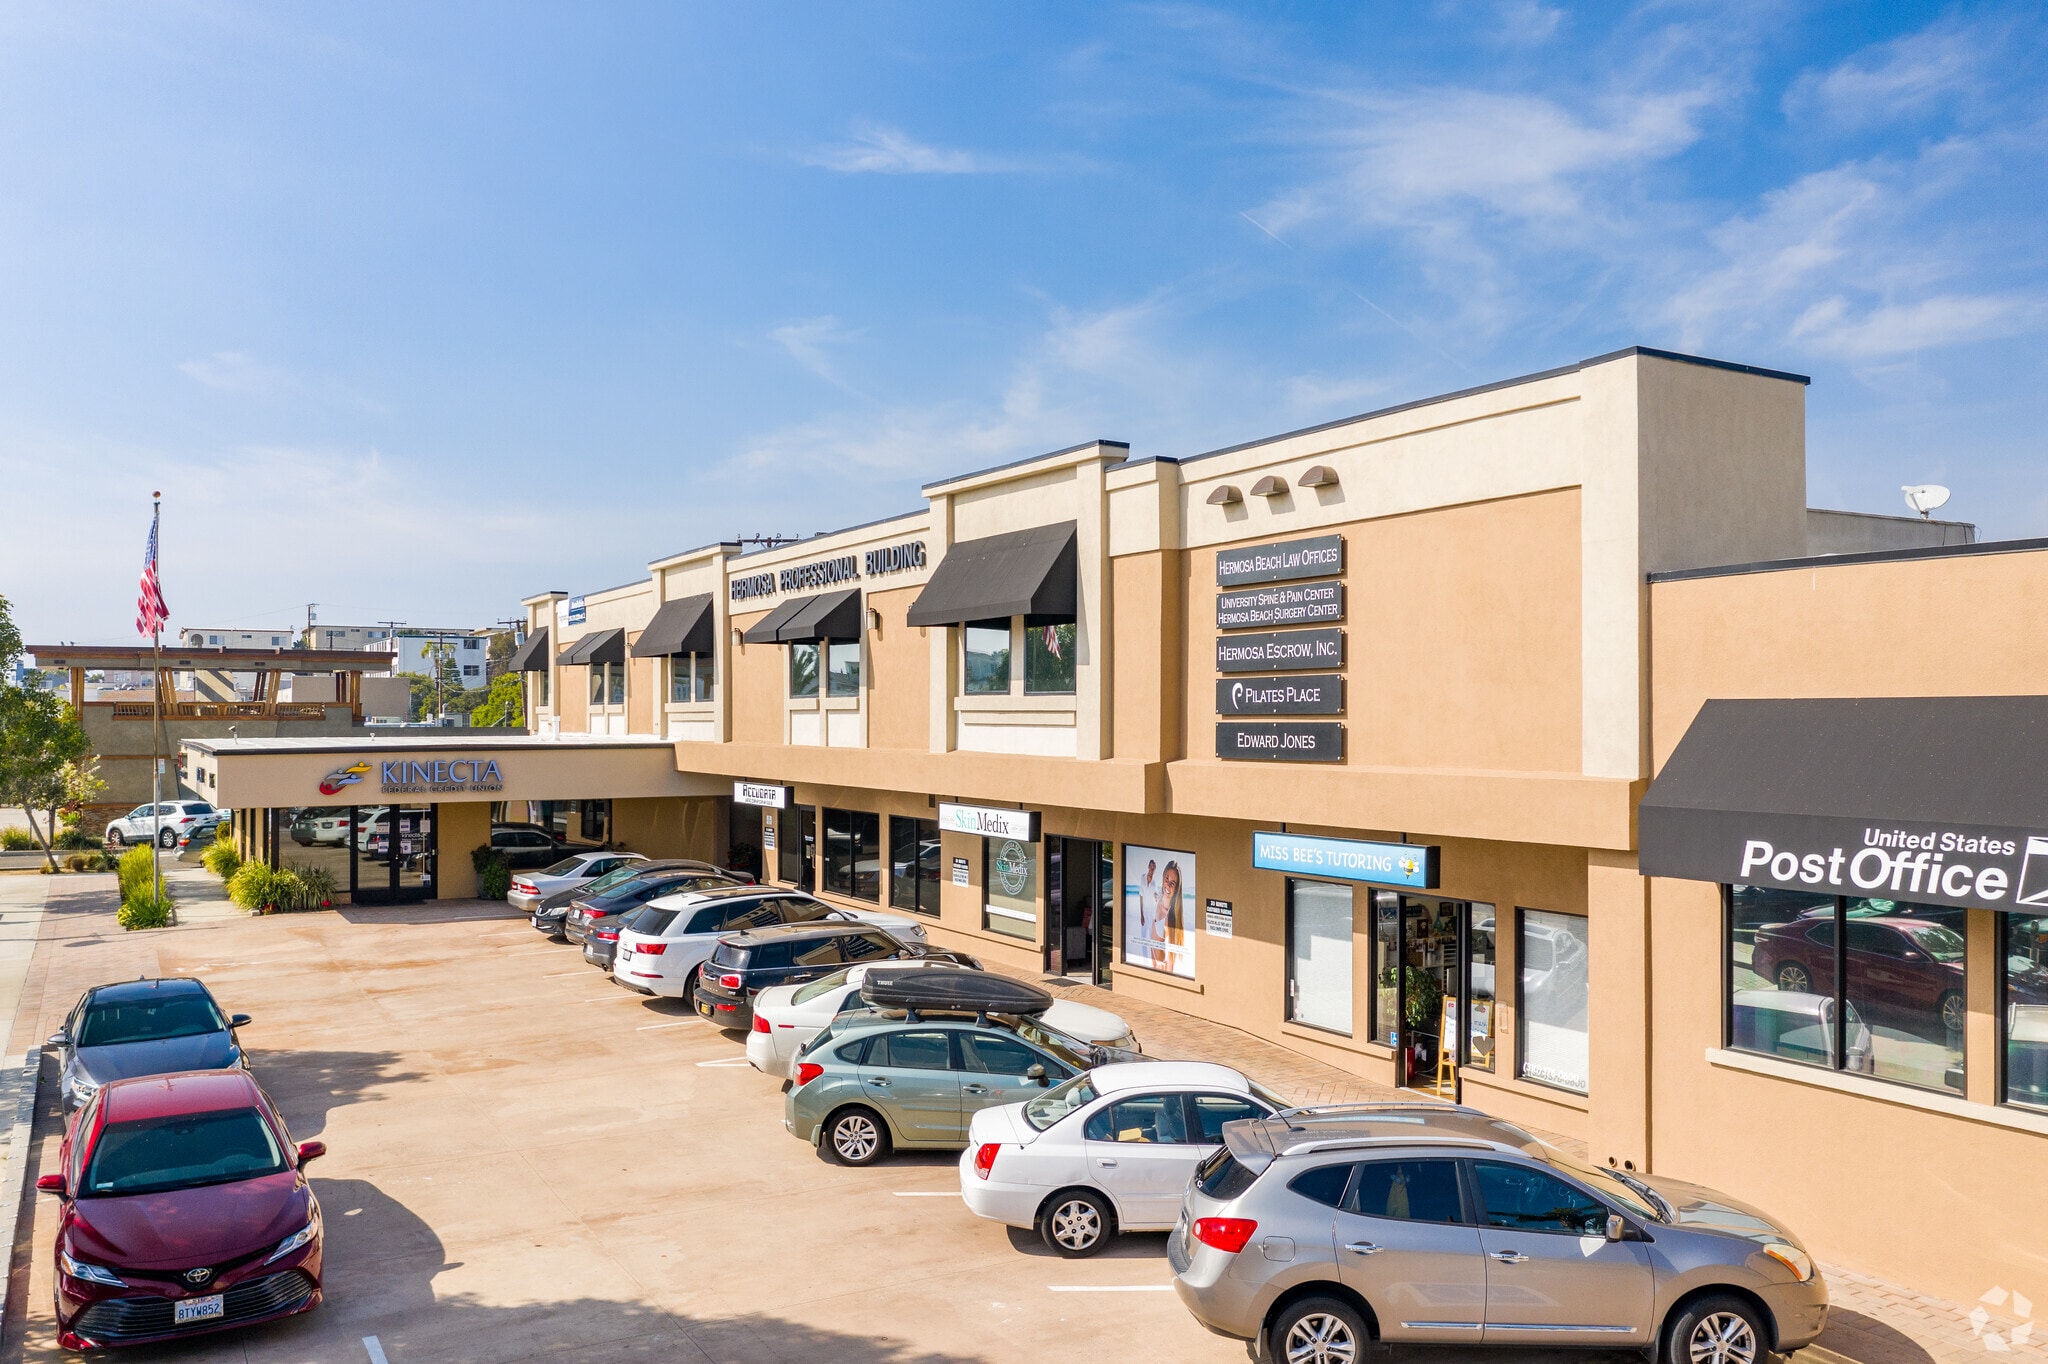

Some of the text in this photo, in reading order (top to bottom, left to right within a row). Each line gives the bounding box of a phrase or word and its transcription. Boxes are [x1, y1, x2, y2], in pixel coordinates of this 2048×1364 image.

[731, 540, 926, 600] HERMOSA PROFESSIONAL BUILDING
[1219, 548, 1338, 576] HERMOSA BEACH LAW OFFICES
[1221, 587, 1334, 609] UNIVERSITY SPINE & PAIN CENTER
[1218, 603, 1338, 624] HERMOSA BEACH SURGERY CENTER
[1218, 639, 1338, 661] HERMOSA ESCROW, INC.
[1245, 687, 1321, 704] PILATES PLACE
[1237, 732, 1316, 749] EDWARD JONES
[381, 759, 504, 785] KINECTA
[381, 784, 504, 794] FEDERAL CREDIT UNION
[955, 808, 1010, 835] SkinMedix
[1863, 828, 2016, 856] United States
[1260, 845, 1392, 872] MISS BEE'S TUTORING
[1740, 840, 2009, 900] Post Office
[178, 1303, 220, 1320] 8TYW852
